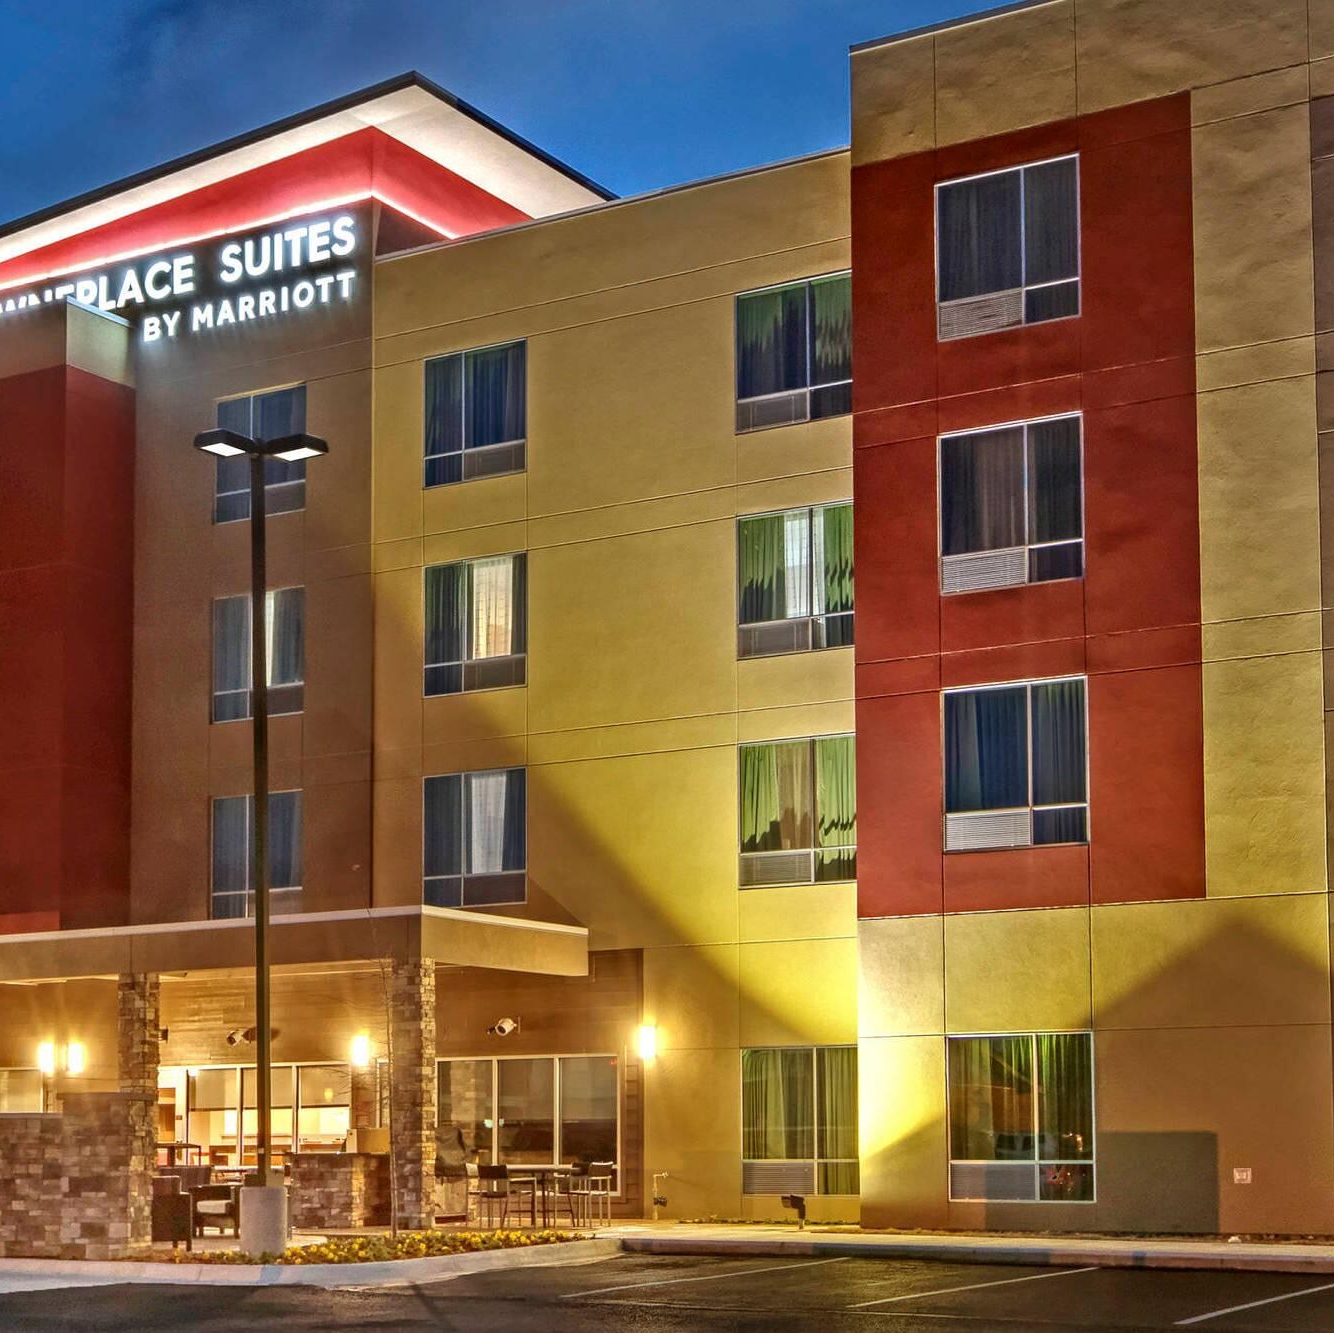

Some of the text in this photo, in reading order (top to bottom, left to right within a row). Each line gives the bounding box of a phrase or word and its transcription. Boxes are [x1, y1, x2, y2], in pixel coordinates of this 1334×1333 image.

[219, 216, 356, 283] SUITES
[143, 271, 356, 342] BY MARRIOTT
